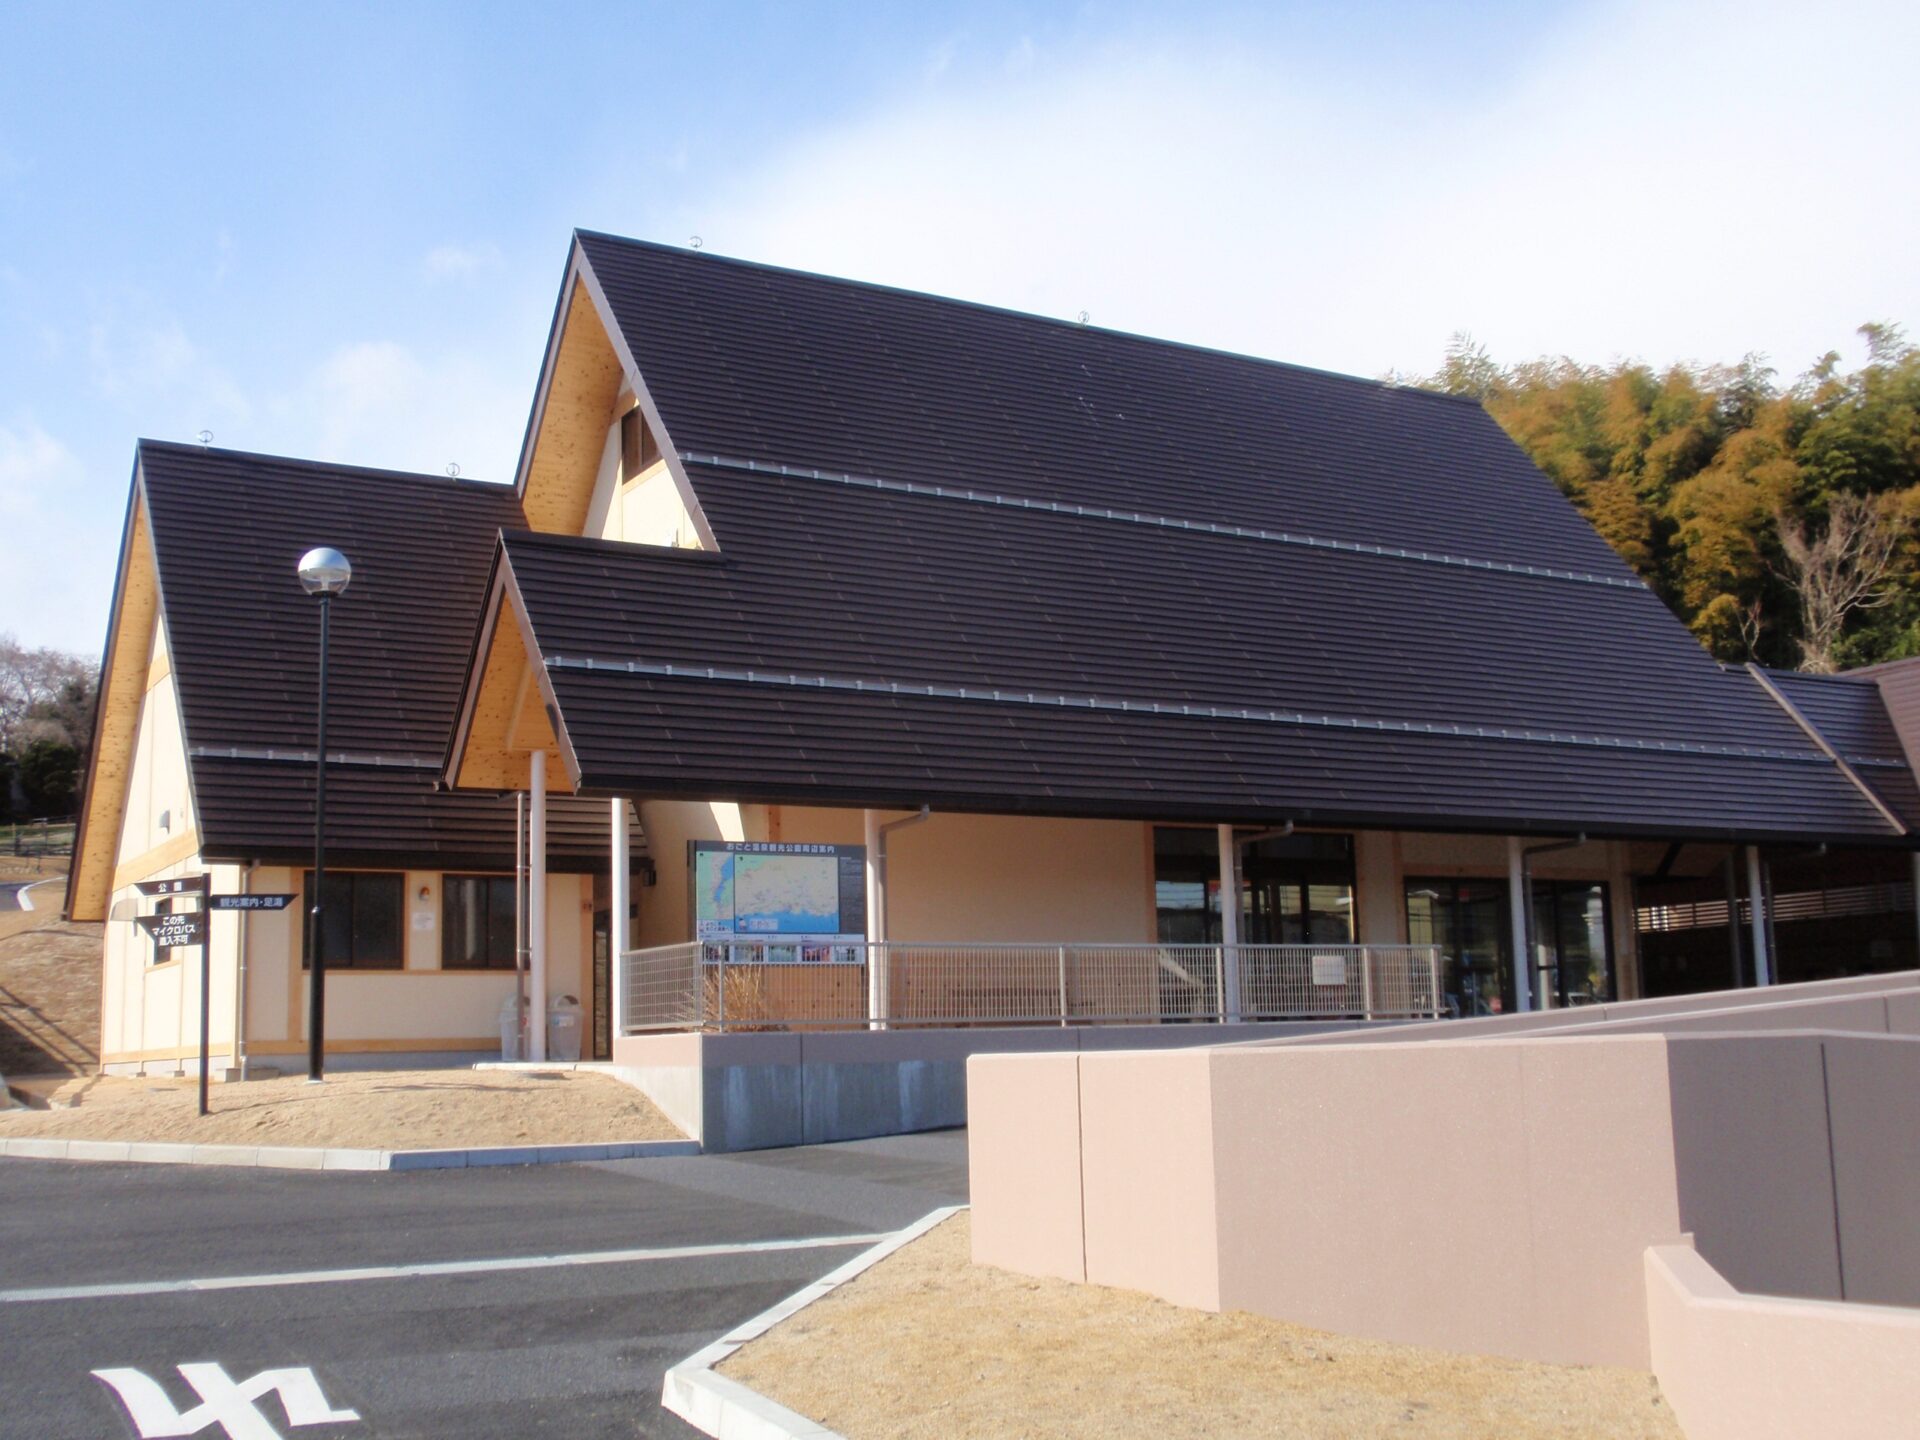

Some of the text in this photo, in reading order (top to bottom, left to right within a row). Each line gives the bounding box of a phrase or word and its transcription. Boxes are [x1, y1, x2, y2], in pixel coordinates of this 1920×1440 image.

[162, 915, 185, 926] この先
[151, 924, 196, 936] マイクロバス
